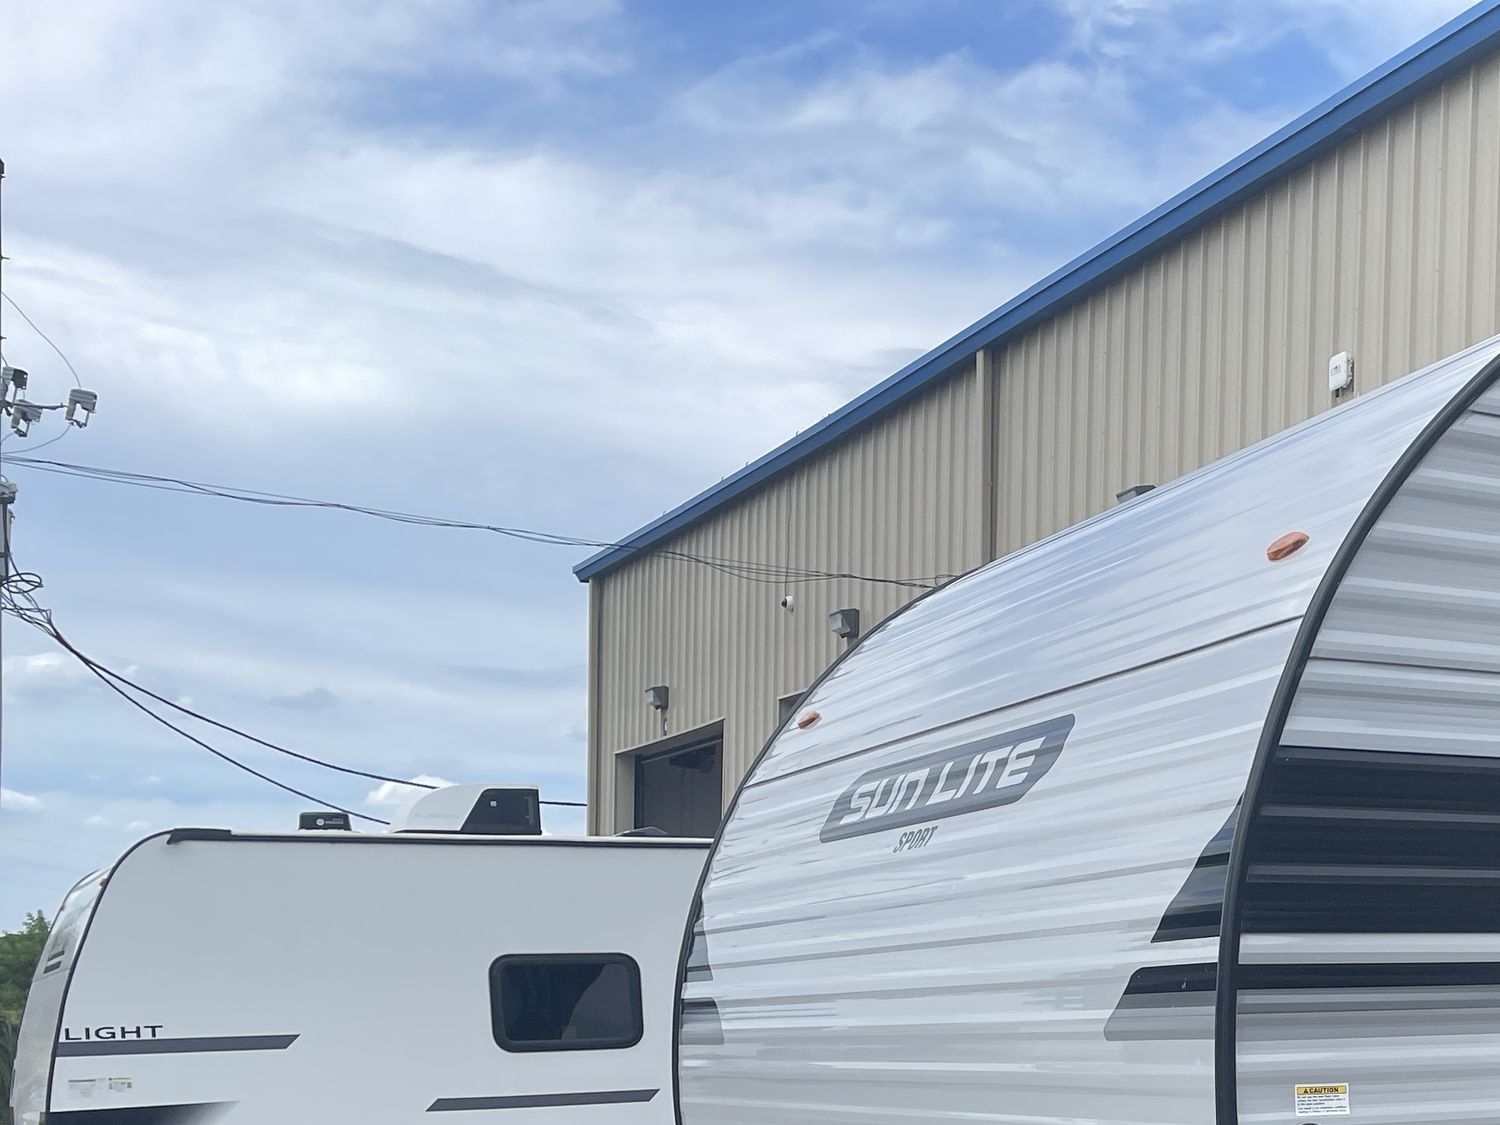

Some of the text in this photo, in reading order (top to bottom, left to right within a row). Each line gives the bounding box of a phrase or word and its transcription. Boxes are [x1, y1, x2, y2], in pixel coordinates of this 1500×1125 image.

[839, 736, 1047, 825] SUN LITE
[893, 825, 938, 854] SPORT
[64, 1025, 163, 1041] LIGHT
